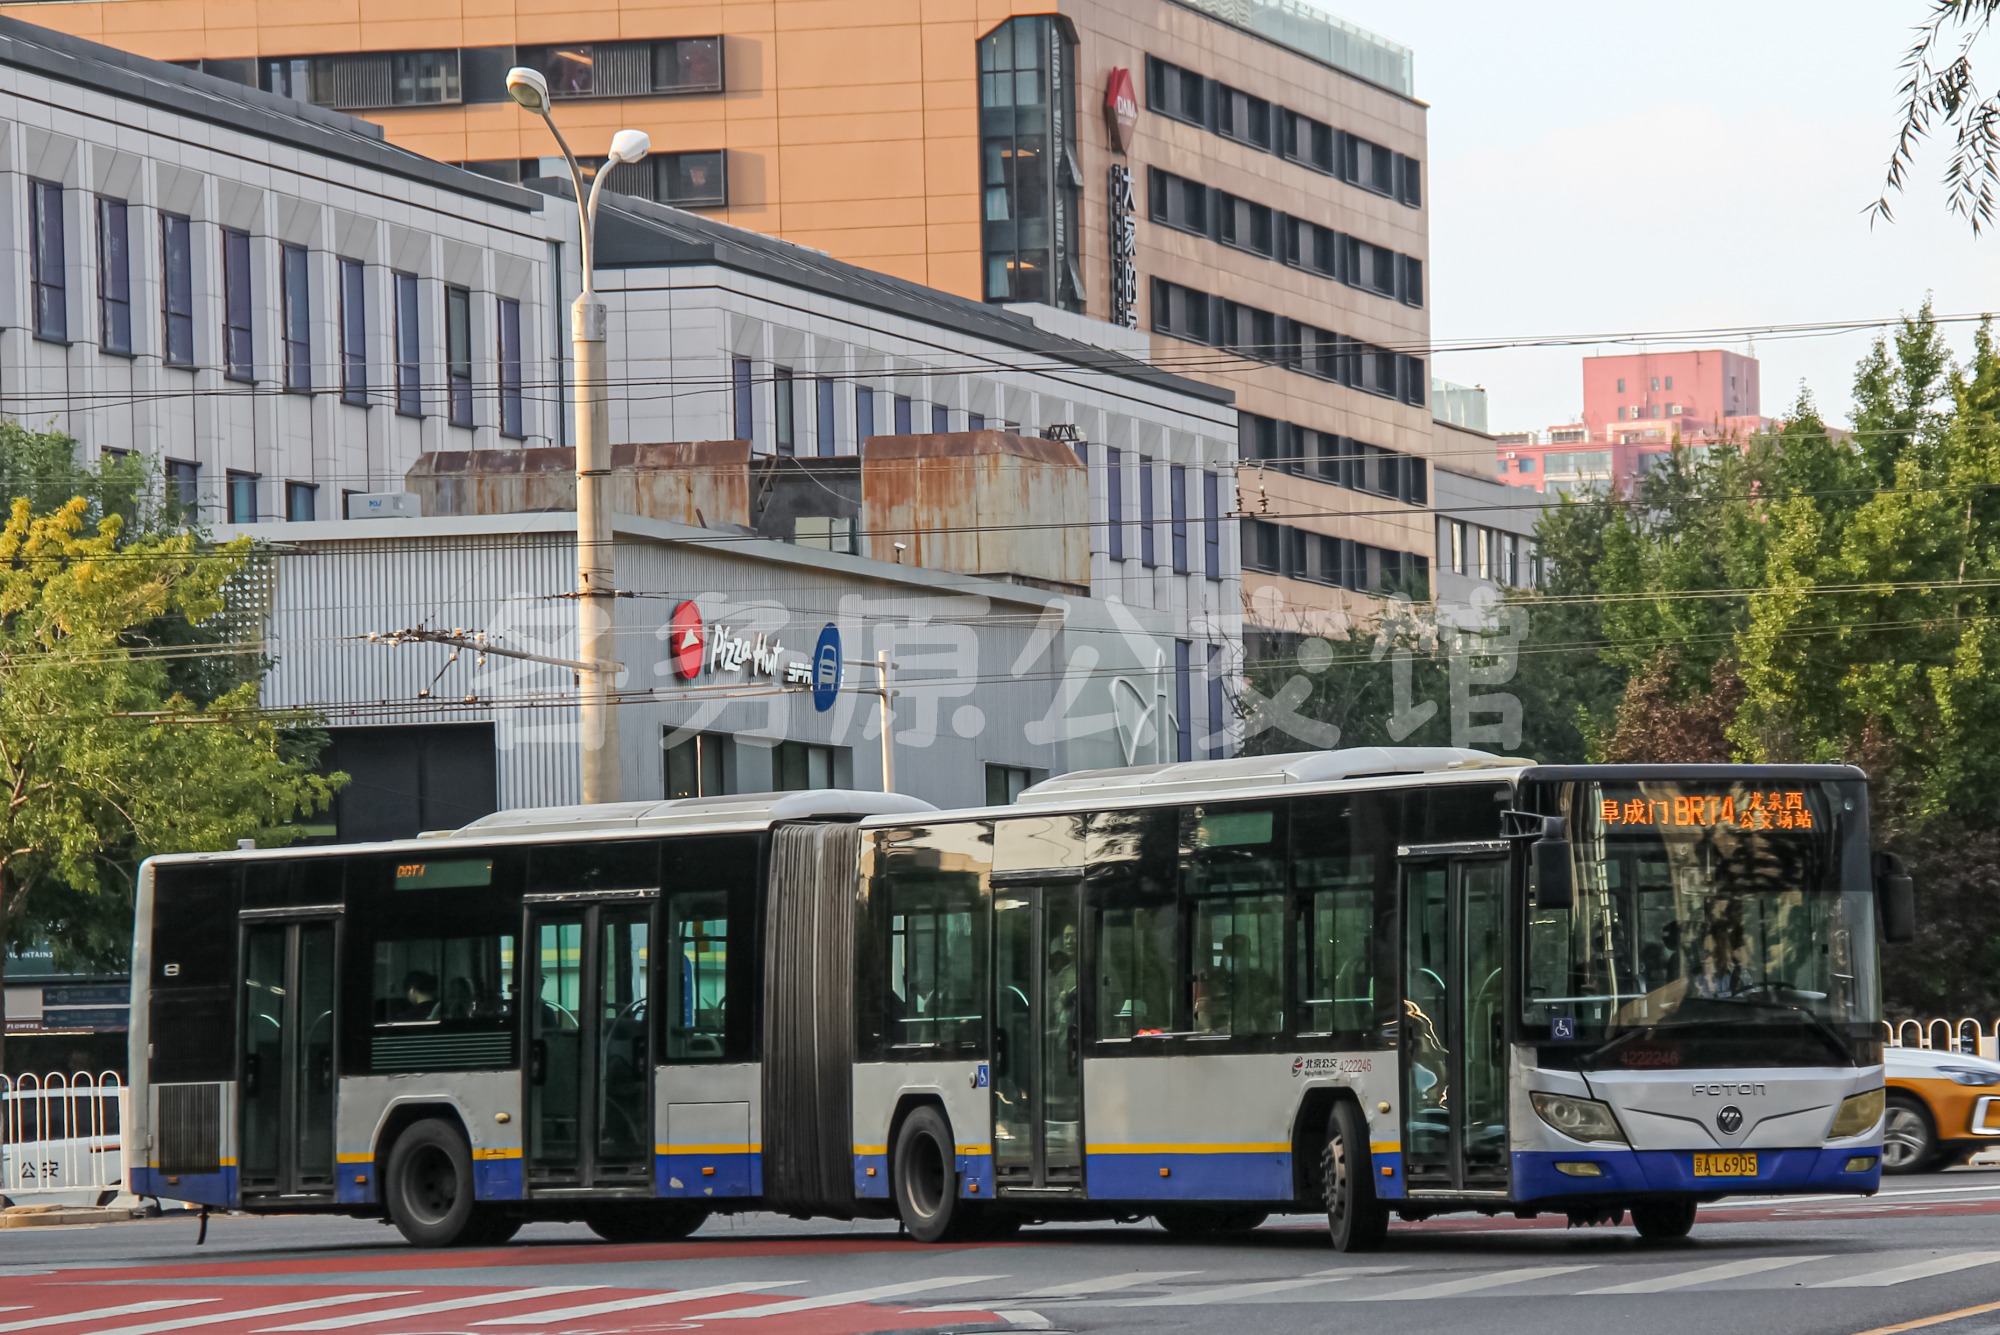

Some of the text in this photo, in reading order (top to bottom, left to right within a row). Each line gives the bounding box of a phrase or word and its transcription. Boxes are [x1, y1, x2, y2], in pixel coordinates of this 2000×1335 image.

[711, 624, 784, 677] Pizza Hut
[1749, 791, 1803, 811] 龙泉西
[1599, 796, 1735, 827] 阜成门 BRT4
[1739, 809, 1813, 830] 公交场站
[1305, 1058, 1372, 1073] 北京公交 4222246
[1621, 1051, 1679, 1065] 4222246
[1692, 1082, 1766, 1097] FOTON
[22, 1160, 59, 1179] 公安
